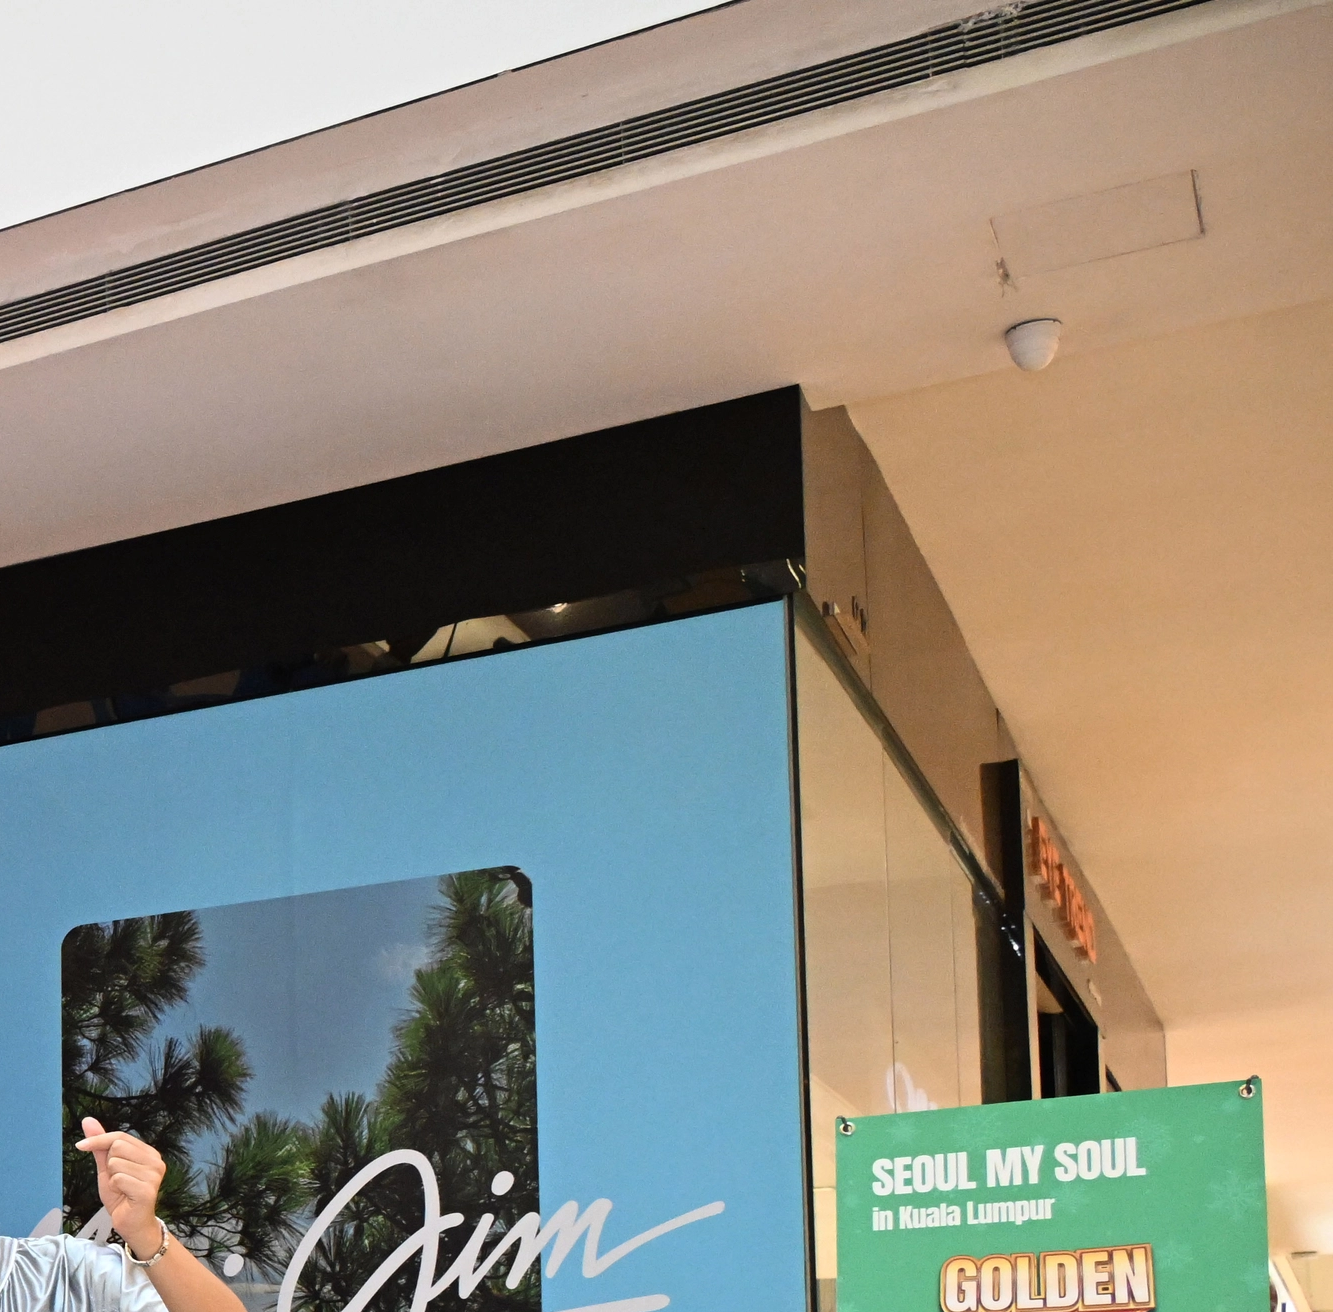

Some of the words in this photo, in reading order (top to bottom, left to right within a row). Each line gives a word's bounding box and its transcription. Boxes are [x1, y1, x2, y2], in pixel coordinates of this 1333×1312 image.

[872, 1152, 976, 1196] SEOUL
[986, 1145, 1045, 1188] MY
[1054, 1137, 1147, 1184] SOUL
[872, 1206, 894, 1231] in
[899, 1201, 960, 1230] Kuala
[966, 1198, 1055, 1226] Lumpur
